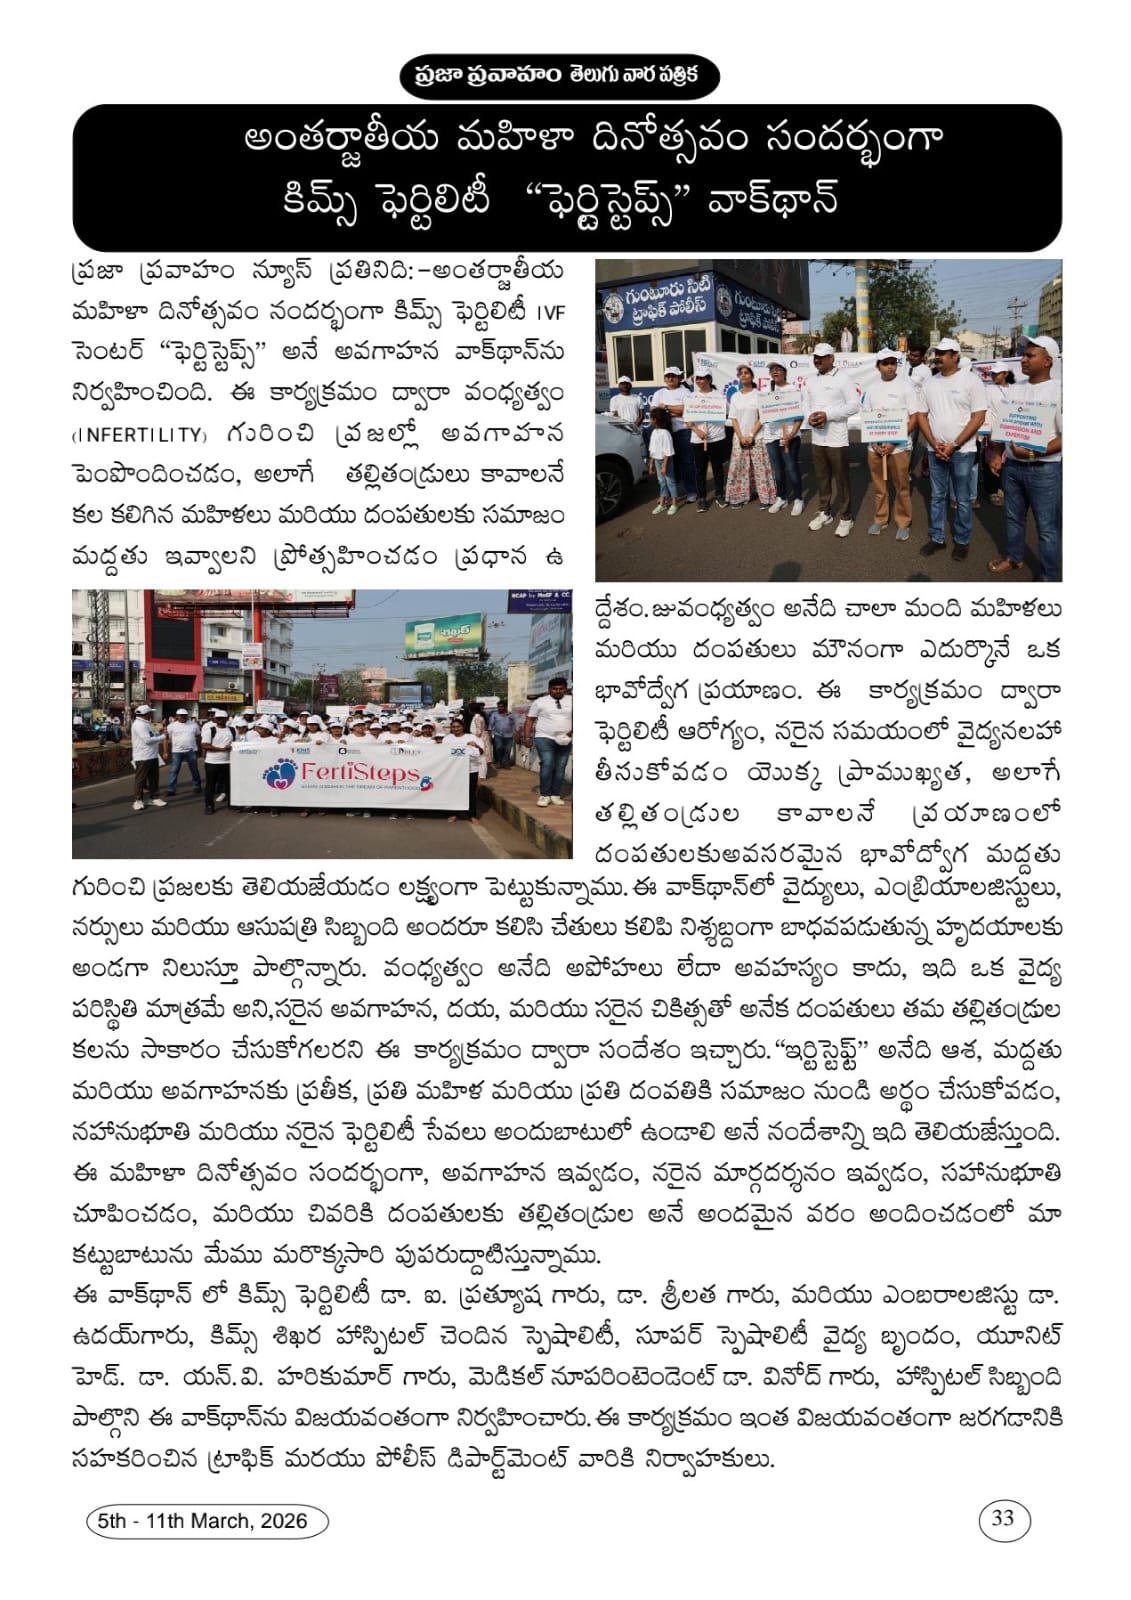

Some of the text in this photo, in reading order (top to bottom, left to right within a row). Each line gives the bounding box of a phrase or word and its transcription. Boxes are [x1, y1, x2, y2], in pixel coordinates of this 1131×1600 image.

[414, 63, 699, 87] ప్రజా ప్రవాహం తెలుగు వార పత్రిక
[244, 111, 944, 169] అంతర్జాతీయ మహిళా దినోత్సవం సందర్భంగా
[283, 178, 358, 227] కిమ్స్
[374, 171, 490, 231] ఫెర్టిలిటీ
[71, 258, 124, 286] ప్రజా
[139, 258, 235, 286] ప్రవాహం
[252, 257, 312, 290] న్యూస్
[72, 299, 149, 320] మహిళా
[158, 295, 259, 330] దినోత్సవం
[394, 297, 442, 330] కిమ్స్
[451, 293, 526, 332] ఫెర్టిలిటీ
[537, 304, 566, 321] IVF
[71, 337, 146, 360] సెంటర్
[282, 335, 318, 360] అనే
[334, 339, 439, 360] అవగాహన
[72, 380, 564, 412] నిర్వహించింది. ఈ కార్యక్రమం ద్వారా వంధ్యత్వం
[227, 421, 314, 442] గురించి
[441, 421, 564, 442] అవగాహన
[71, 458, 564, 491] పెంపొందించడం, అలాగే తల్లితండ్రులు కావాలనే
[72, 503, 565, 525] కల కలిగిన మహిళలు మరియు దంపతులకు సమాజం
[72, 542, 564, 577] మద్దతు ఇవ్వాలని ప్రోత్సహించడం ప్రధాన ఉ
[783, 592, 1063, 617] అనేది చాలా మంది మహిళలు
[595, 633, 1061, 669] మరియు దంపతులు మౌనంగా ఎదుర్కొనే ఒక
[595, 674, 1062, 710] భావోద్వేగ ప్రయాణం. ఈ కార్యక్రమం ద్వారా
[594, 713, 669, 753] ఫెర్టిలిటీ
[678, 715, 765, 751] ఆరోగ్యం,
[832, 715, 950, 740] సమయంలో
[301, 761, 421, 786] FertiSteps
[595, 756, 1061, 792] తీసుకోవడం యొక్క ప్రాముఖ్యత, అలాగే
[595, 797, 876, 830] తల్లితండ్రుల కావాలనే
[986, 842, 1061, 876] మద్దతు
[72, 956, 149, 978] అండగా
[162, 956, 239, 985] నిలుస్తూ
[383, 956, 483, 988] వంధ్యత్వం
[497, 952, 551, 977] అనేది
[566, 954, 663, 977] అపోహలు
[677, 952, 721, 977] లేదా
[734, 956, 838, 988] అవహస్యం
[852, 956, 907, 981] కాదు,
[922, 957, 957, 980] ఇది
[971, 956, 1005, 977] ఒక
[1018, 956, 1063, 988] వైద్య
[72, 1079, 153, 1100] మరియు
[161, 1079, 288, 1100] అవగాహనకు
[296, 1075, 358, 1107] ప్రతీక,
[367, 1079, 408, 1107] ప్రతి
[416, 1079, 485, 1100] మహిళ
[491, 1079, 573, 1100] మరియు
[580, 1079, 620, 1107] ప్రతి
[720, 1079, 805, 1101] సమాజం
[813, 1078, 871, 1101] నుండి
[879, 1079, 930, 1114] అర్థం
[938, 1075, 1061, 1104] చేసుకోవడం,
[72, 1198, 1062, 1231] చూపించడం, మరియు చివరికి దంపతులకు తల్లితండ్రుల అనే అందమైన వరం అందించడంలో మా
[71, 1446, 198, 1468] సహకరించిన
[207, 1445, 275, 1475] ట్రాఫిక్
[376, 1442, 436, 1468] పోలీస్
[578, 1446, 635, 1468] వారికి
[645, 1446, 775, 1478] నిర్వాహకులు.
[98, 1512, 126, 1530] 5th
[146, 1512, 184, 1530] 11th
[191, 1512, 254, 1532] March,
[260, 1512, 308, 1530] 2026
[991, 1508, 1014, 1526] 33
